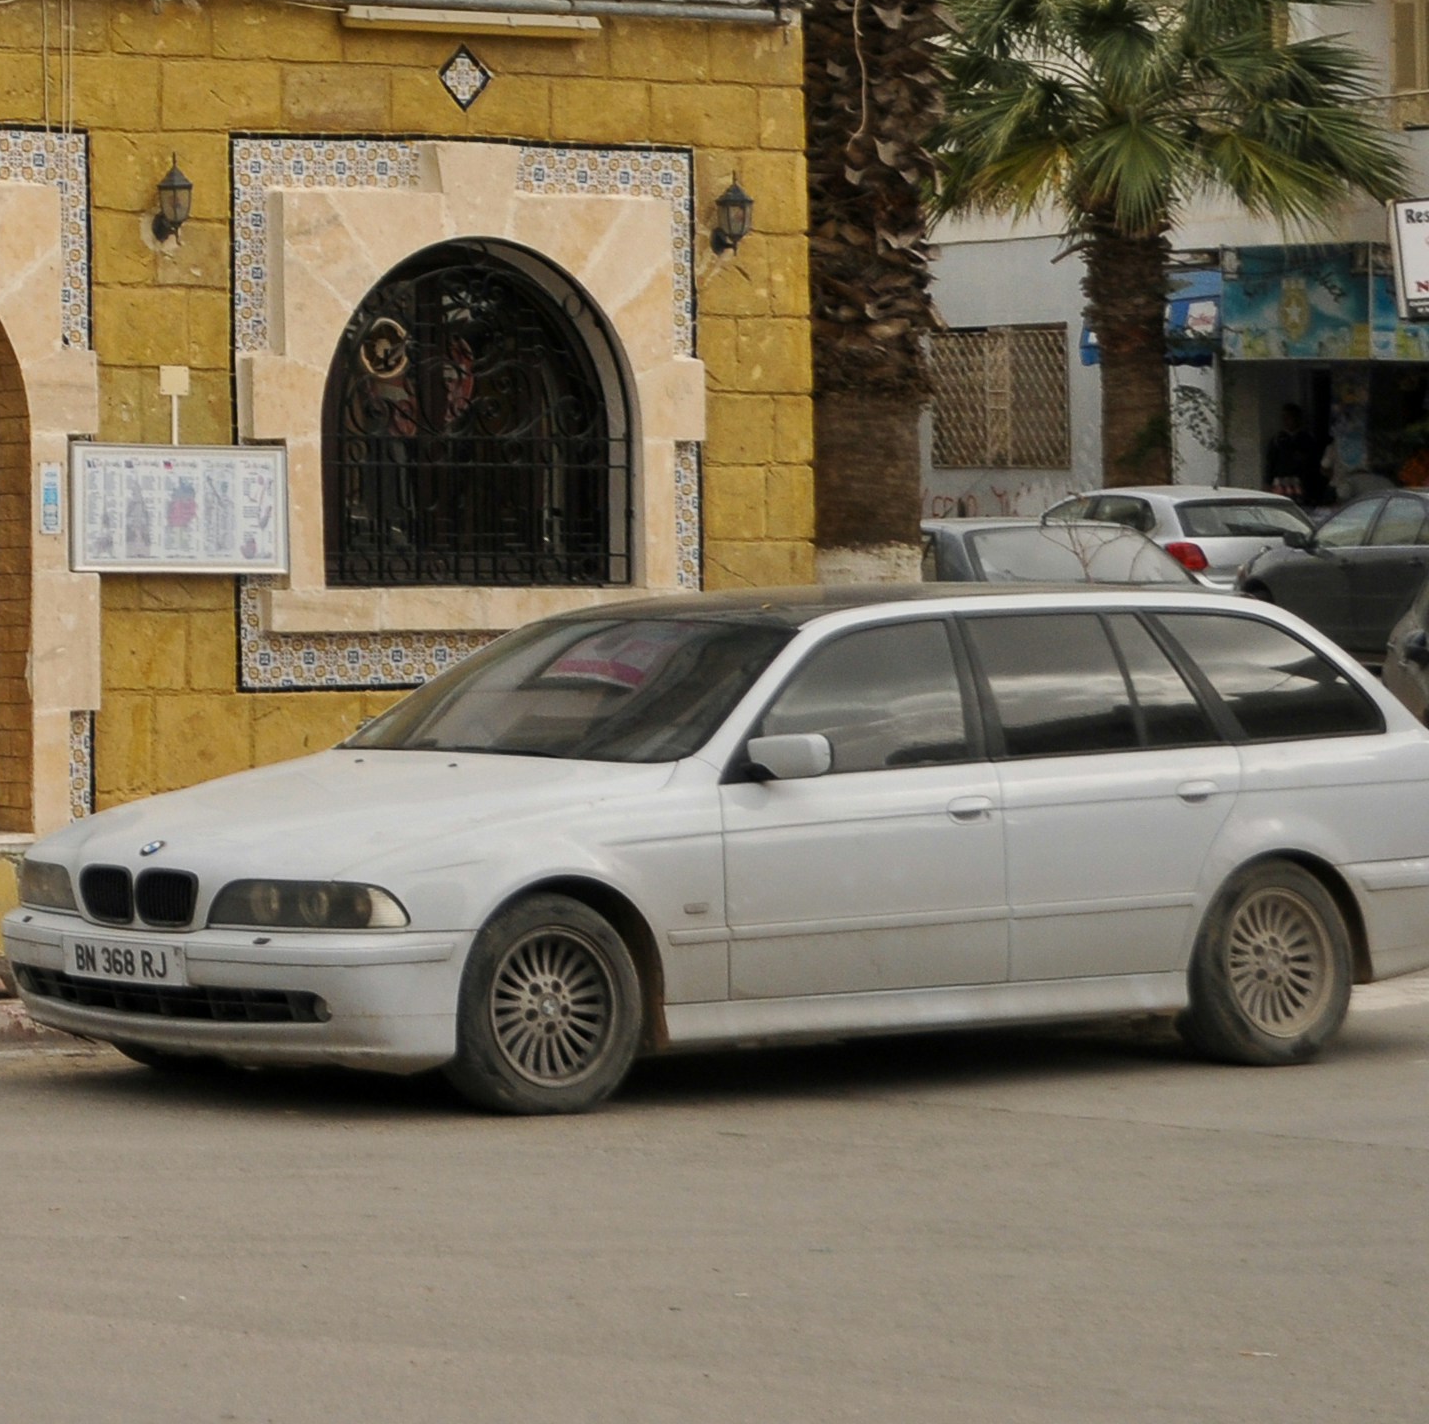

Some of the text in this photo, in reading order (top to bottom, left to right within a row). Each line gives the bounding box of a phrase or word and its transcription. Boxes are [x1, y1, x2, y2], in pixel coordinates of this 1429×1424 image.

[75, 943, 167, 978] BN 368 RJ
